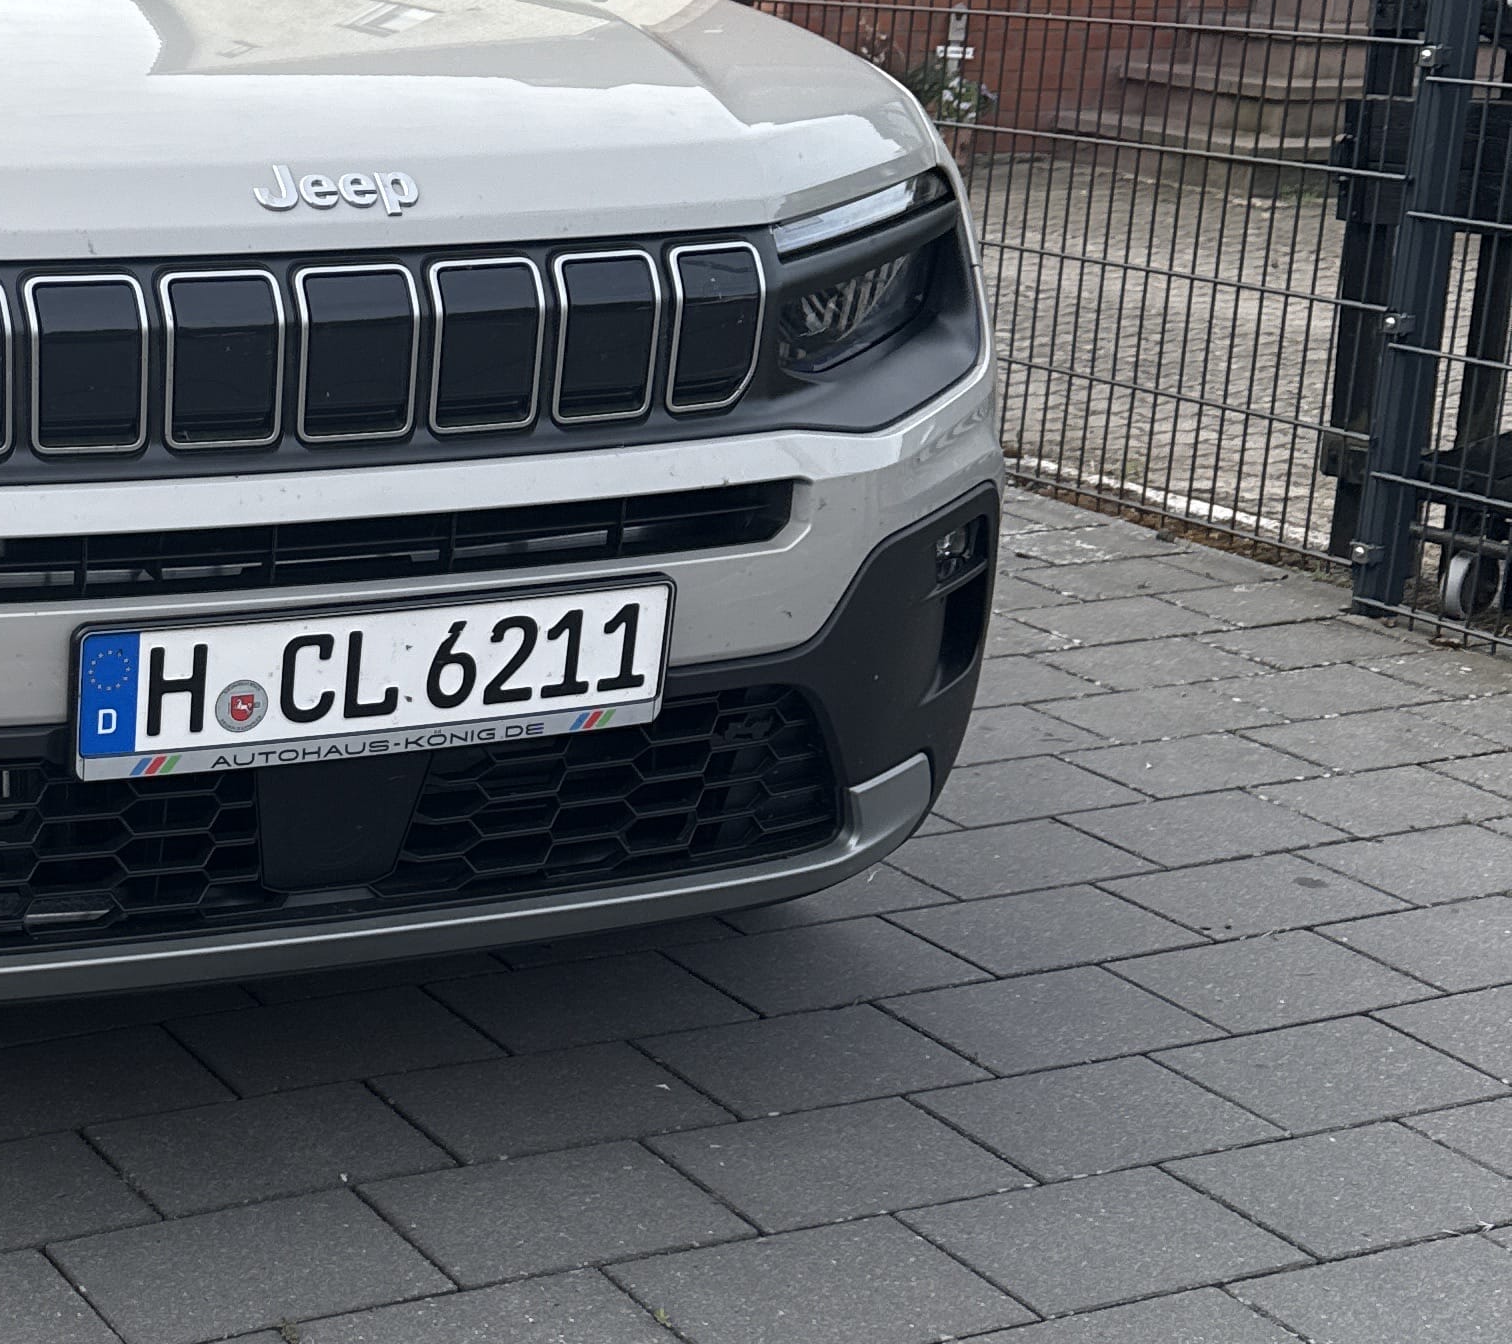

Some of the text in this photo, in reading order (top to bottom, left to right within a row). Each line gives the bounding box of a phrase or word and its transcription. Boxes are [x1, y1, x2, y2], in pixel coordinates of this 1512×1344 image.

[253, 164, 419, 216] Jeep
[147, 602, 645, 737] H CL 6211
[97, 708, 117, 735] D
